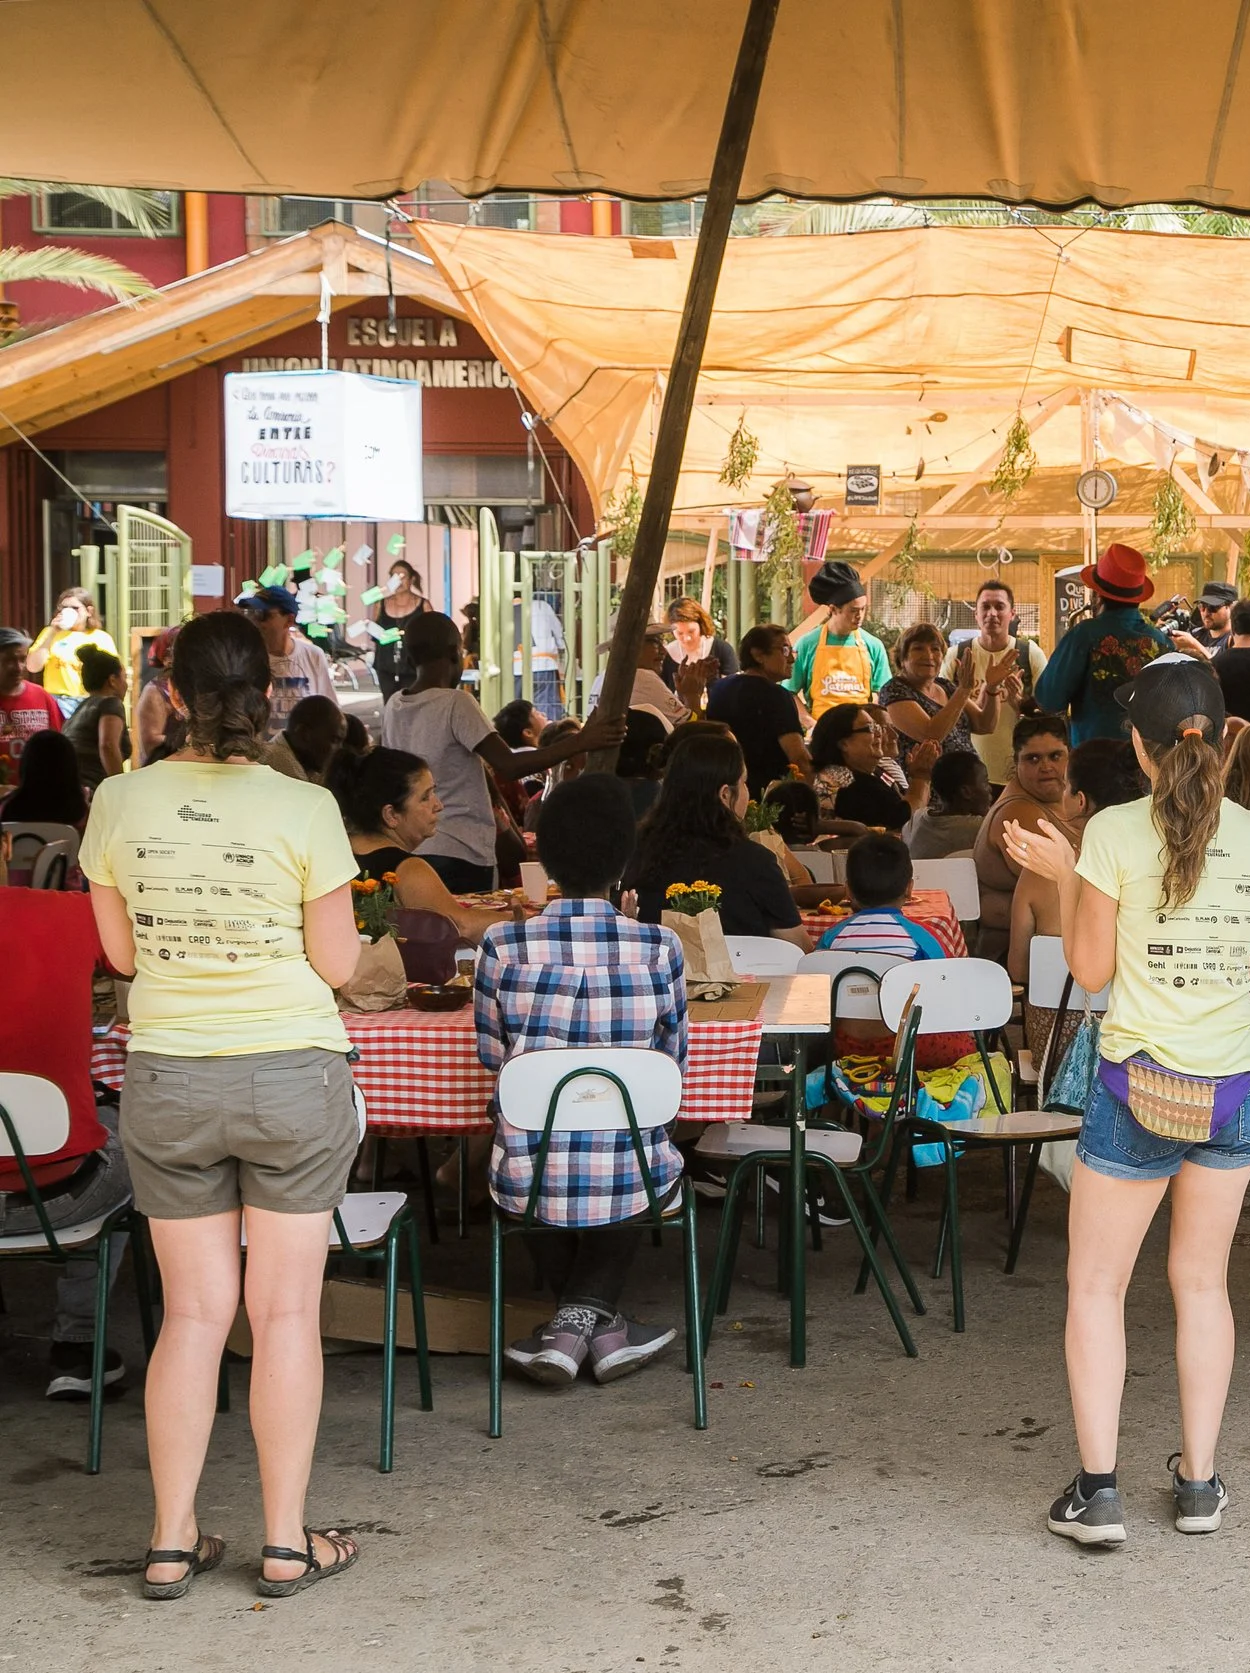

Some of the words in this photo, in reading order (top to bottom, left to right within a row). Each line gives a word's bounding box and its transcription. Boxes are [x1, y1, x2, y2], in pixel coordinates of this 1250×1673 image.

[346, 318, 458, 348] ESCUELA
[259, 426, 312, 440] ENTRE
[241, 460, 337, 484] CULTURAS?
[1148, 960, 1166, 969] Gehl
